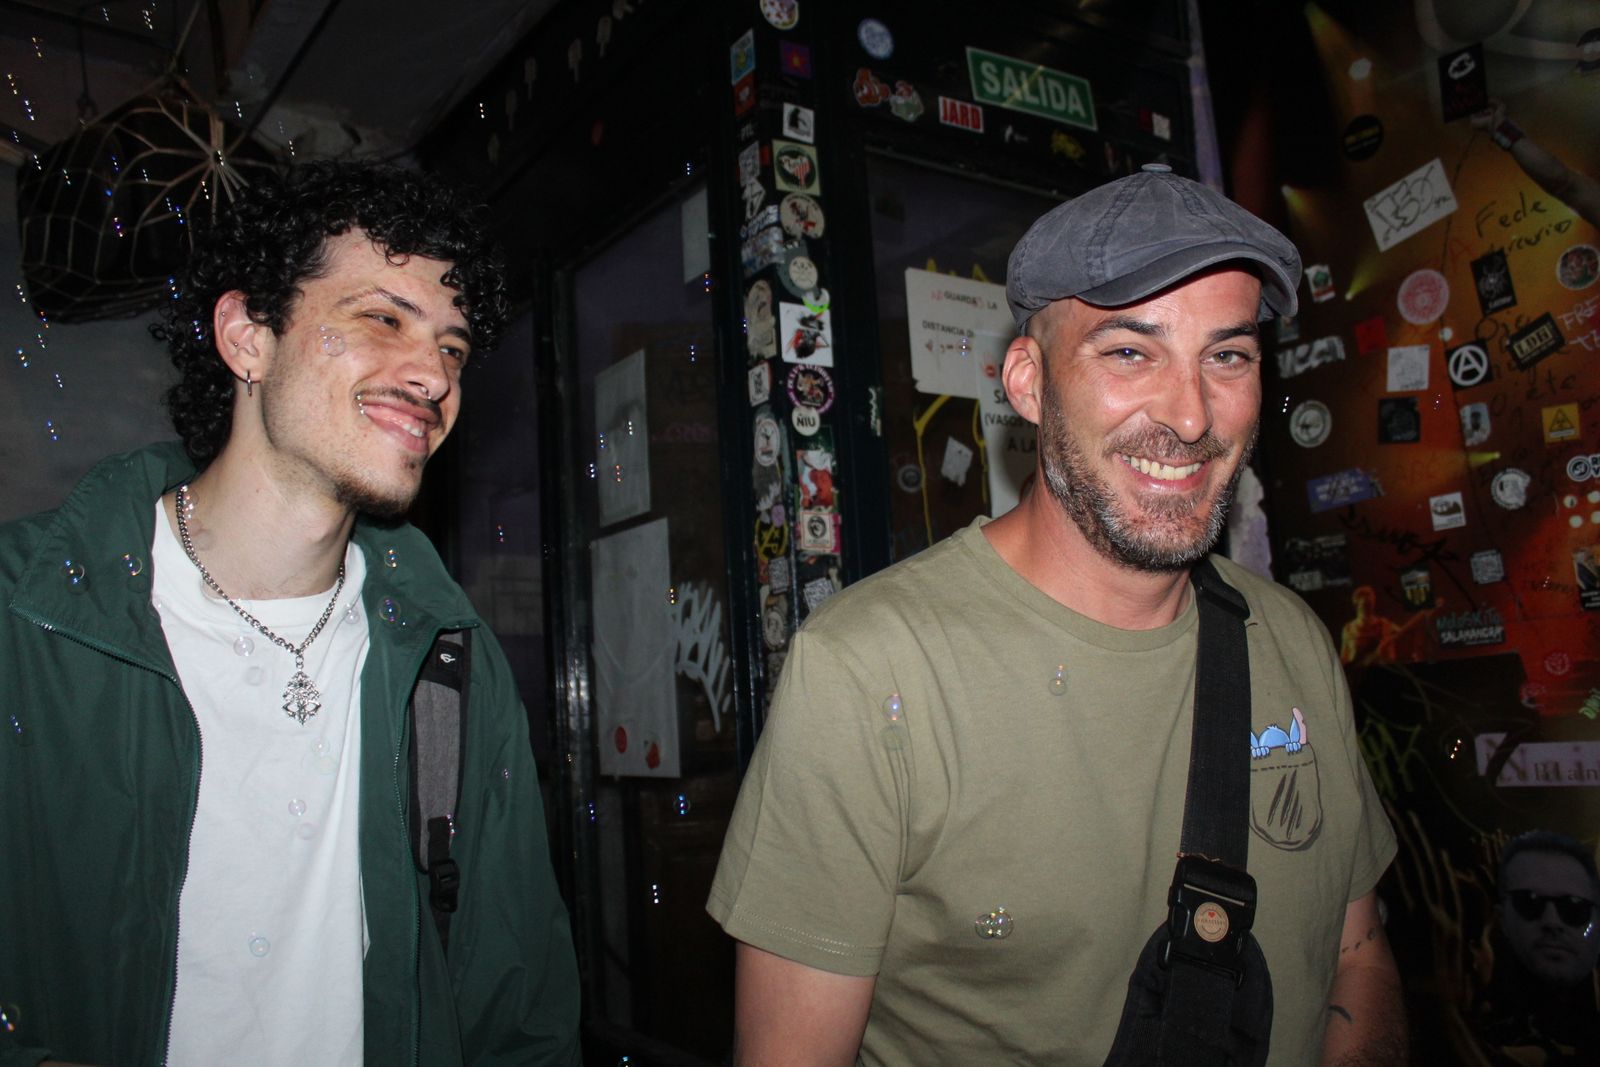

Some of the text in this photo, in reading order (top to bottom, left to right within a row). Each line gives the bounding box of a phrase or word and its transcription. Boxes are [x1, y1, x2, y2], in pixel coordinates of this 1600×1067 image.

[980, 61, 1087, 118] SALIDA
[987, 301, 998, 311] LA
[922, 319, 965, 337] DISTANCIA
